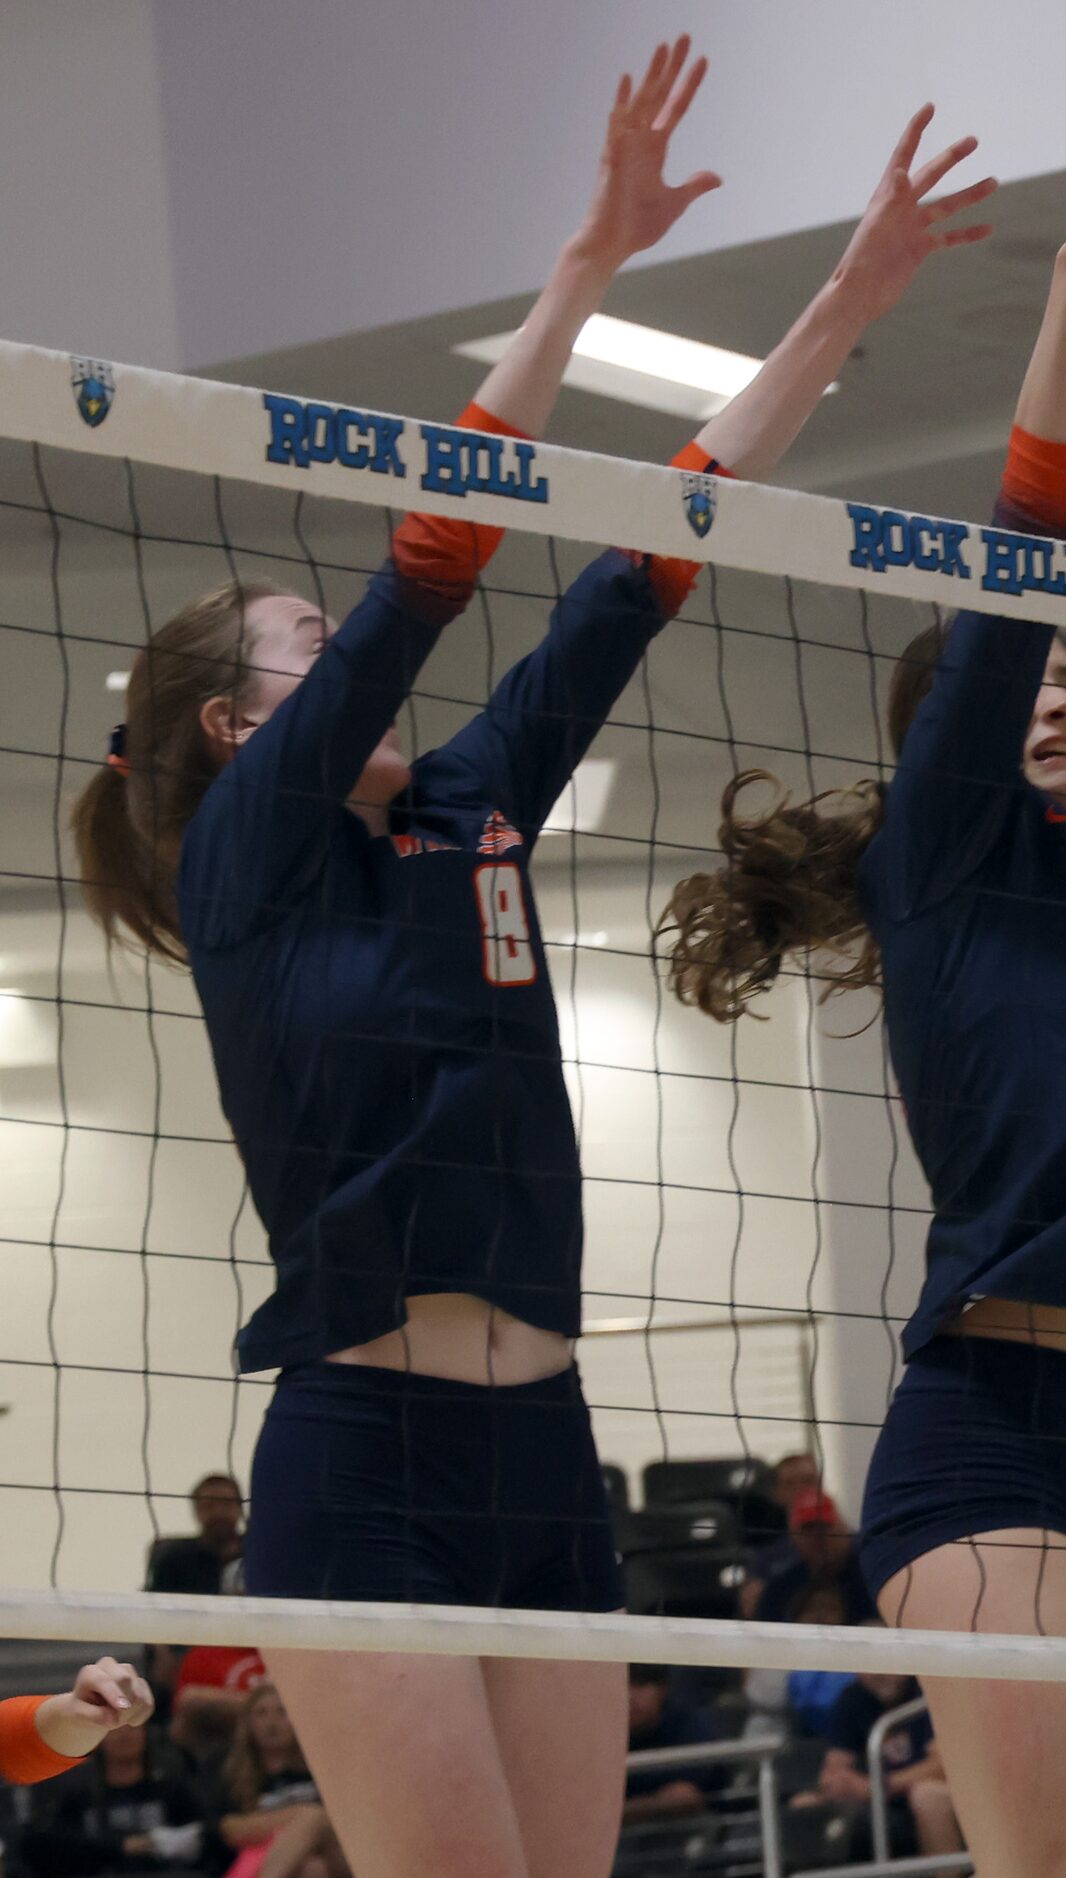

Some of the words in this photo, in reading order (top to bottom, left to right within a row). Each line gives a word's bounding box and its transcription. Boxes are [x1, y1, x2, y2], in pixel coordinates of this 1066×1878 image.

[263, 393, 406, 478] ROCK
[420, 424, 549, 503] HILL
[847, 502, 971, 579] ROCK
[471, 862, 538, 987] 8
